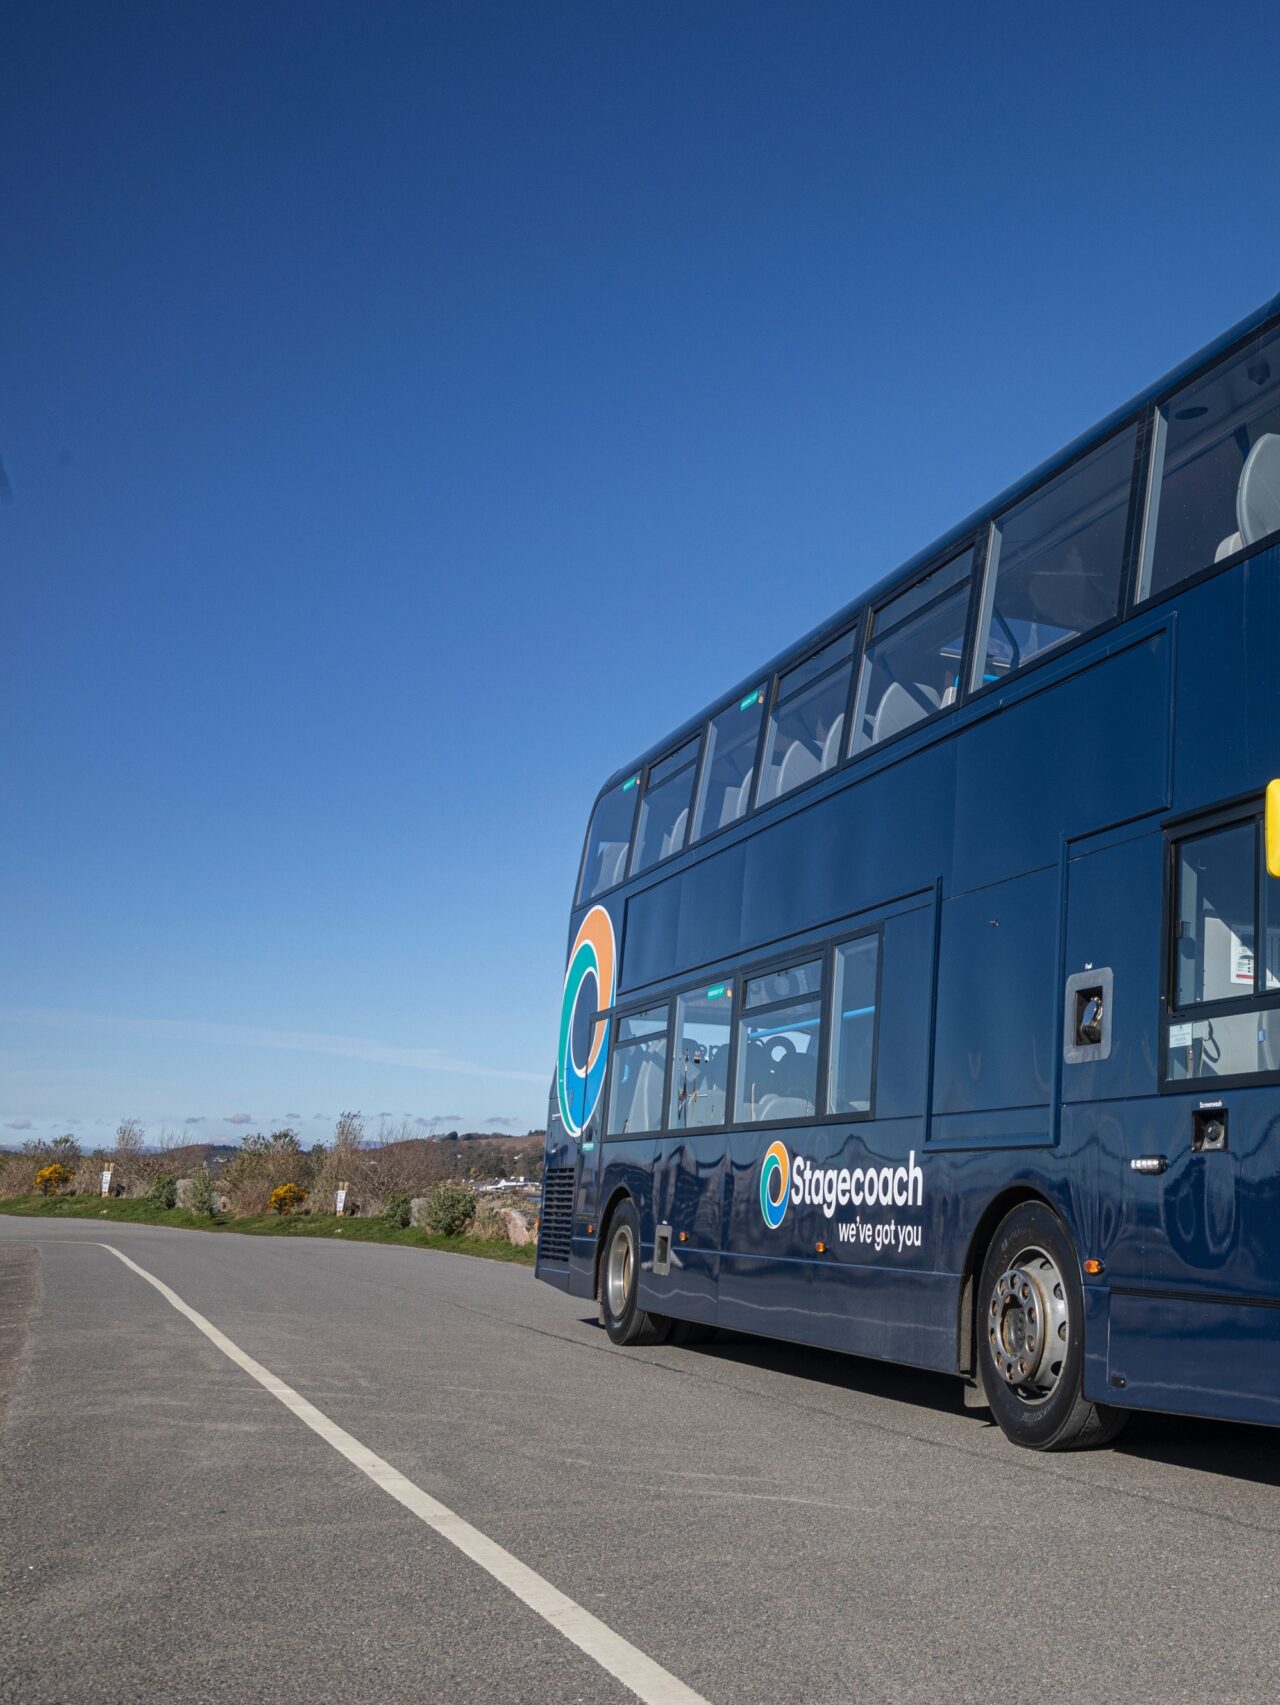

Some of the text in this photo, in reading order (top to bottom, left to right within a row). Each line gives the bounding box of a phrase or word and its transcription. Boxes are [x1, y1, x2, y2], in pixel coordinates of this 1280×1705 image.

[791, 1150, 923, 1218] Stagecoach
[838, 1216, 922, 1253] we've got you
